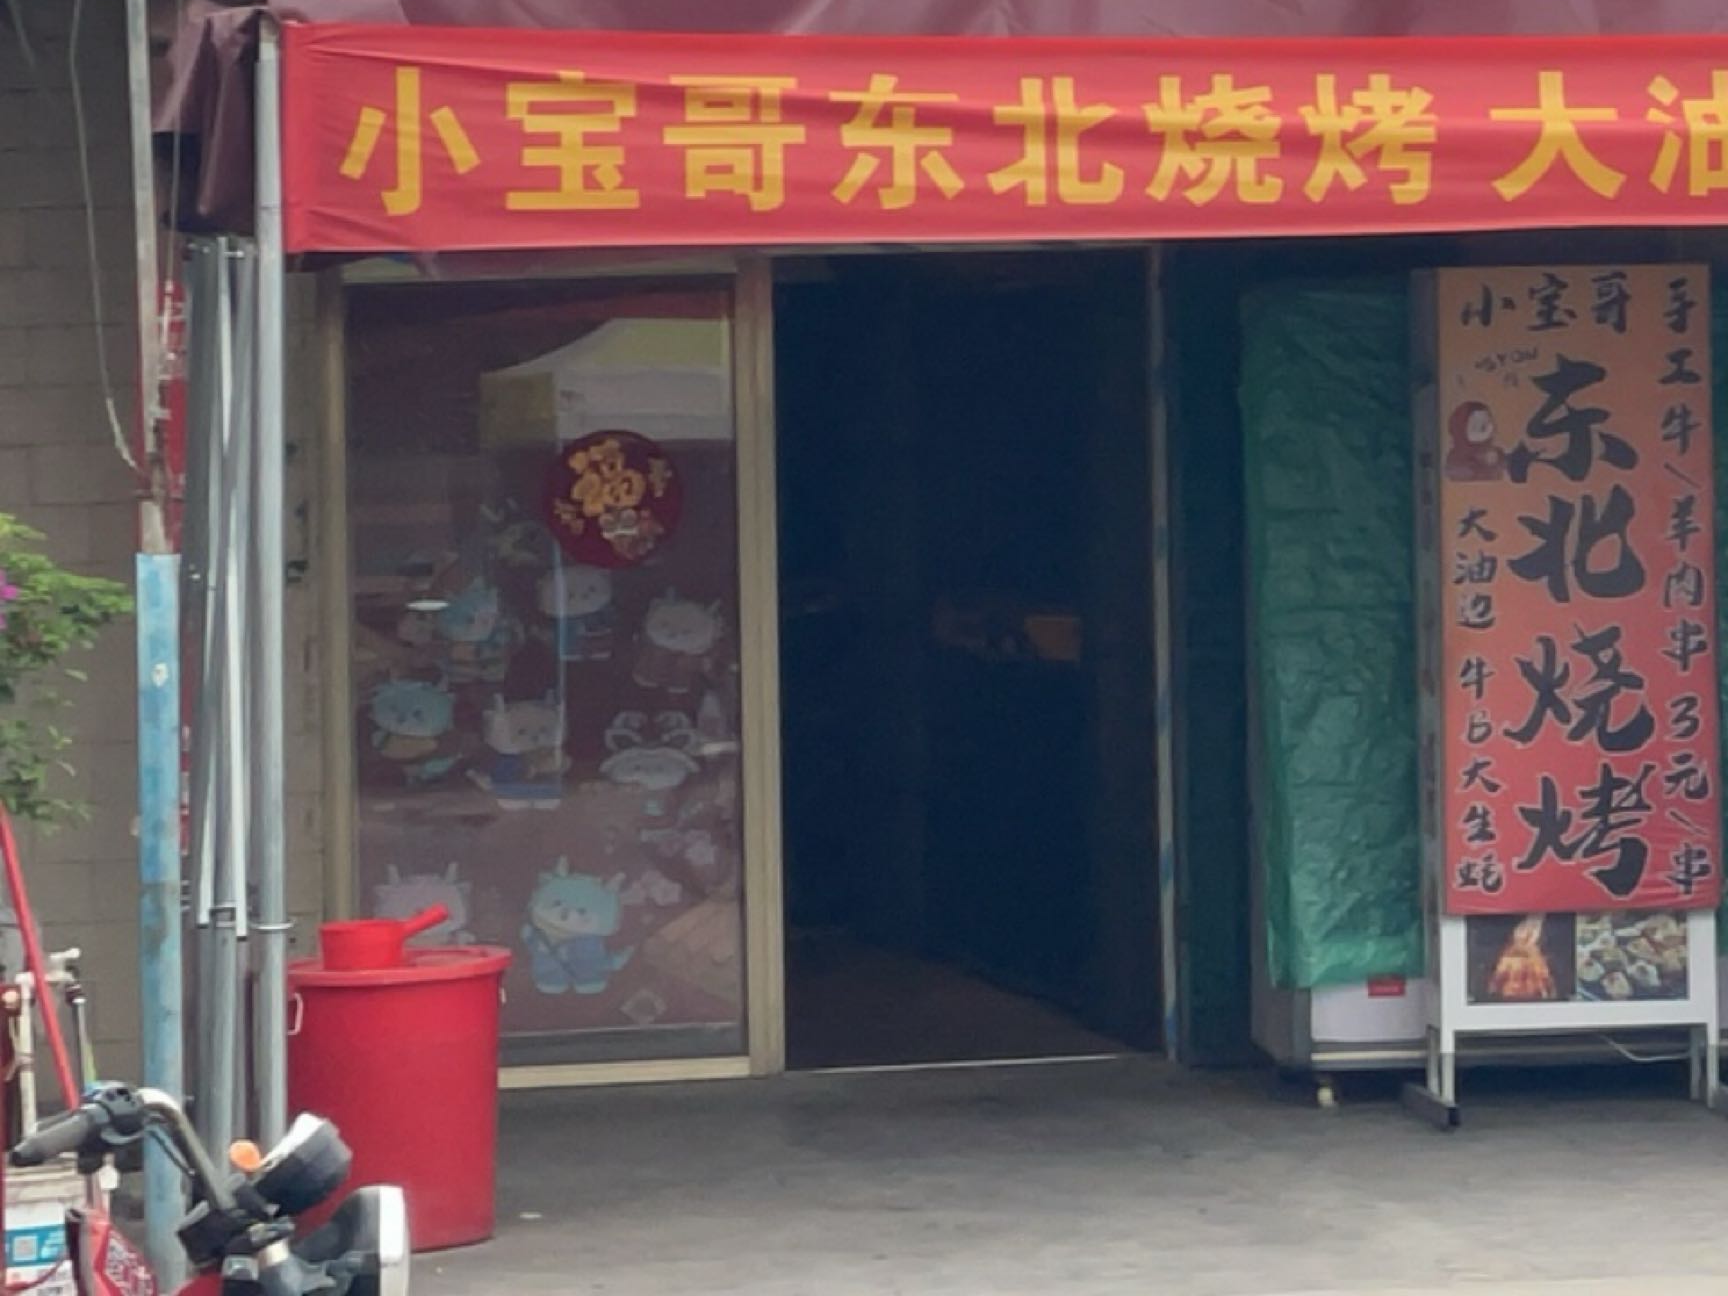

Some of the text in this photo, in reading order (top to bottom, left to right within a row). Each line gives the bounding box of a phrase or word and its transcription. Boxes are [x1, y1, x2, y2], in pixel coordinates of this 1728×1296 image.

[340, 65, 1438, 216] 小宝哥东北烧烤
[1459, 270, 1632, 335] 小宝哥
[1453, 507, 1499, 631] 大油边
[1502, 352, 1657, 897] 东北烧烤
